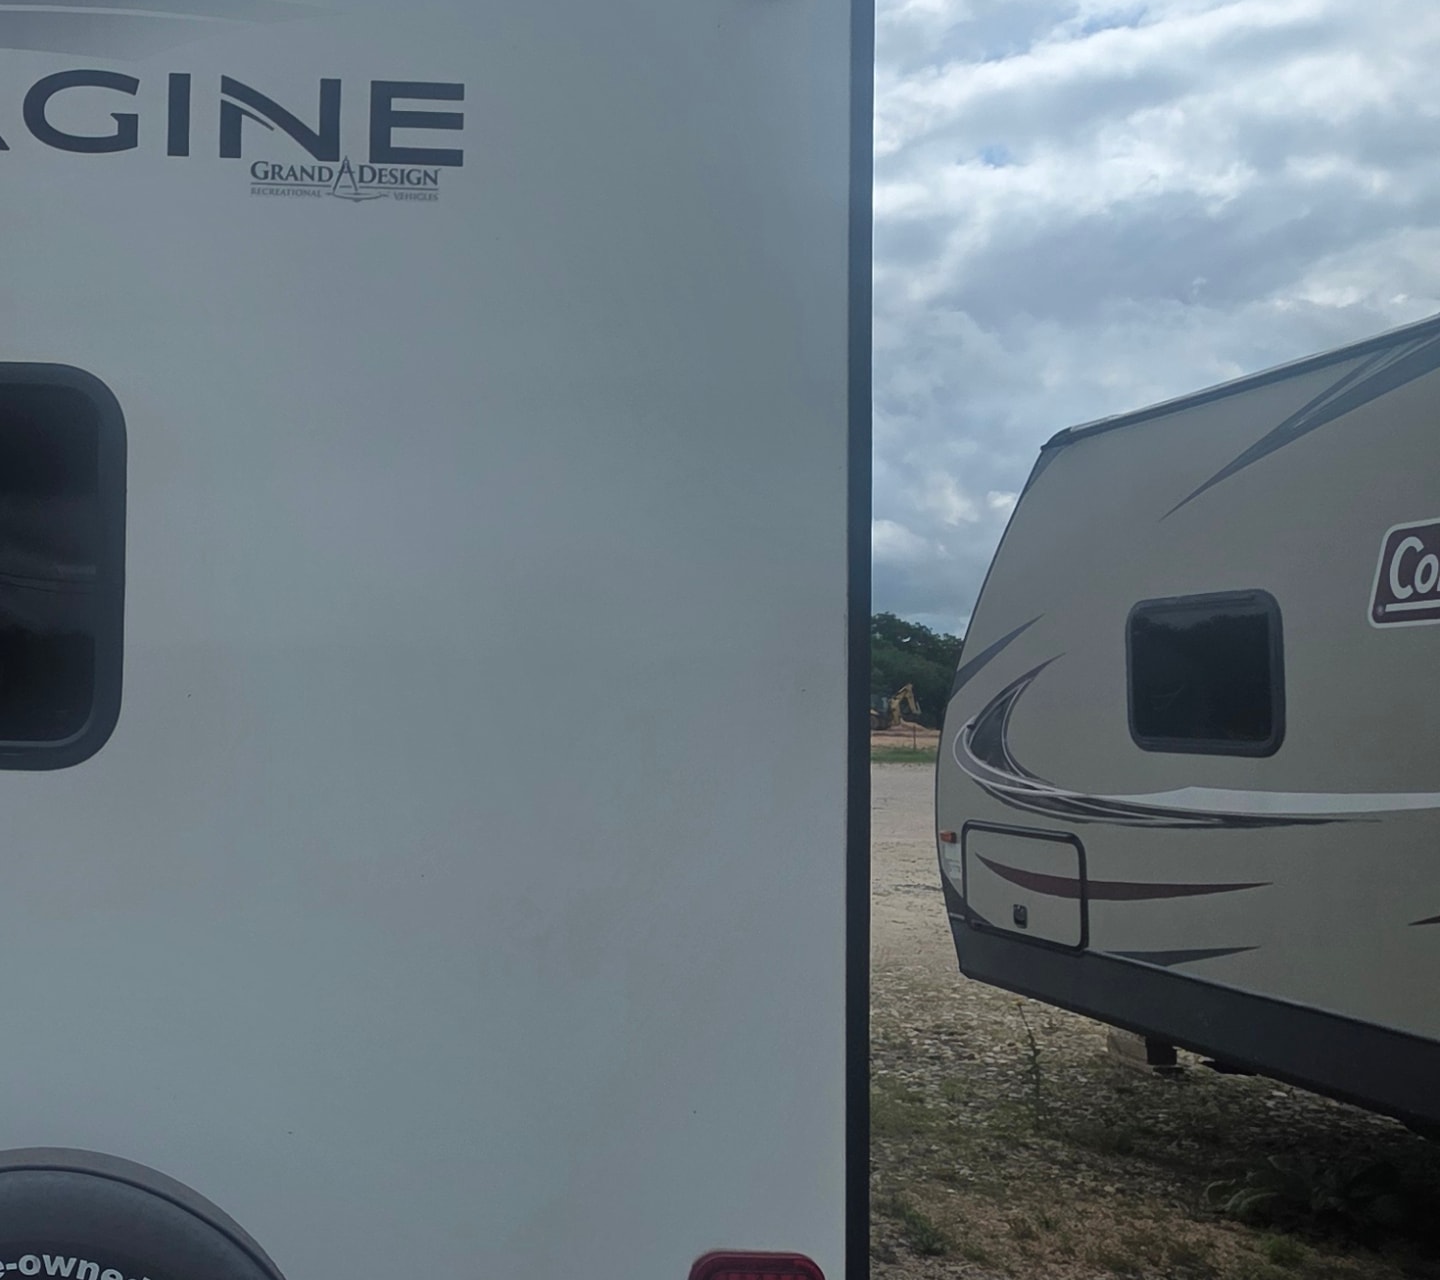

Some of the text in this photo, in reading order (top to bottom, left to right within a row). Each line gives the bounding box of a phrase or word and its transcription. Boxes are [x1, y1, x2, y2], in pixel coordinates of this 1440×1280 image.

[250, 160, 439, 186] GRAND DESIGN
[250, 186, 439, 202] RECREATIONAL VEHICLES
[1389, 535, 1440, 600] Co
